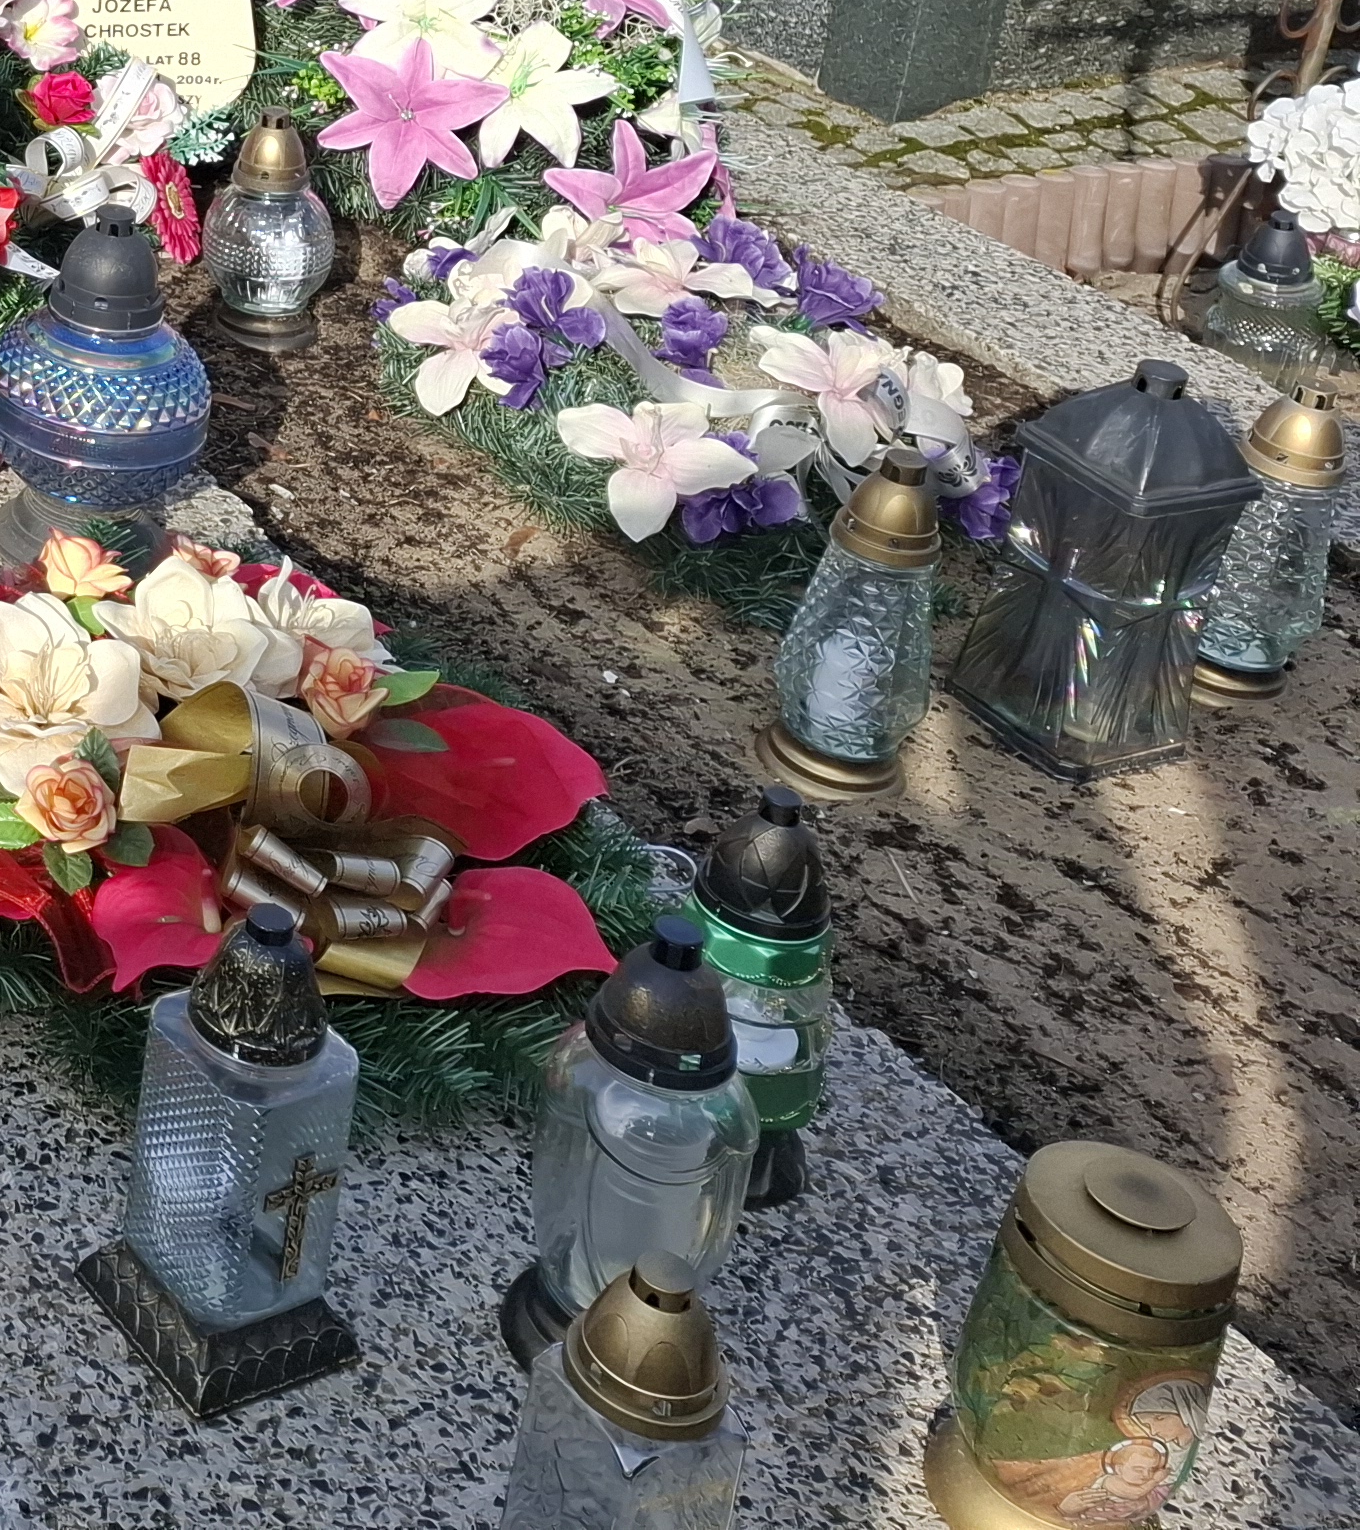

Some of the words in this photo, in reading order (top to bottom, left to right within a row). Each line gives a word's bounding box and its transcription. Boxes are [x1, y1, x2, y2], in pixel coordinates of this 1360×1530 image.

[84, 22, 191, 39] CHROSTEK
[145, 54, 174, 66] LAT
[177, 52, 201, 67] 88
[176, 74, 223, 86] 2004r.
